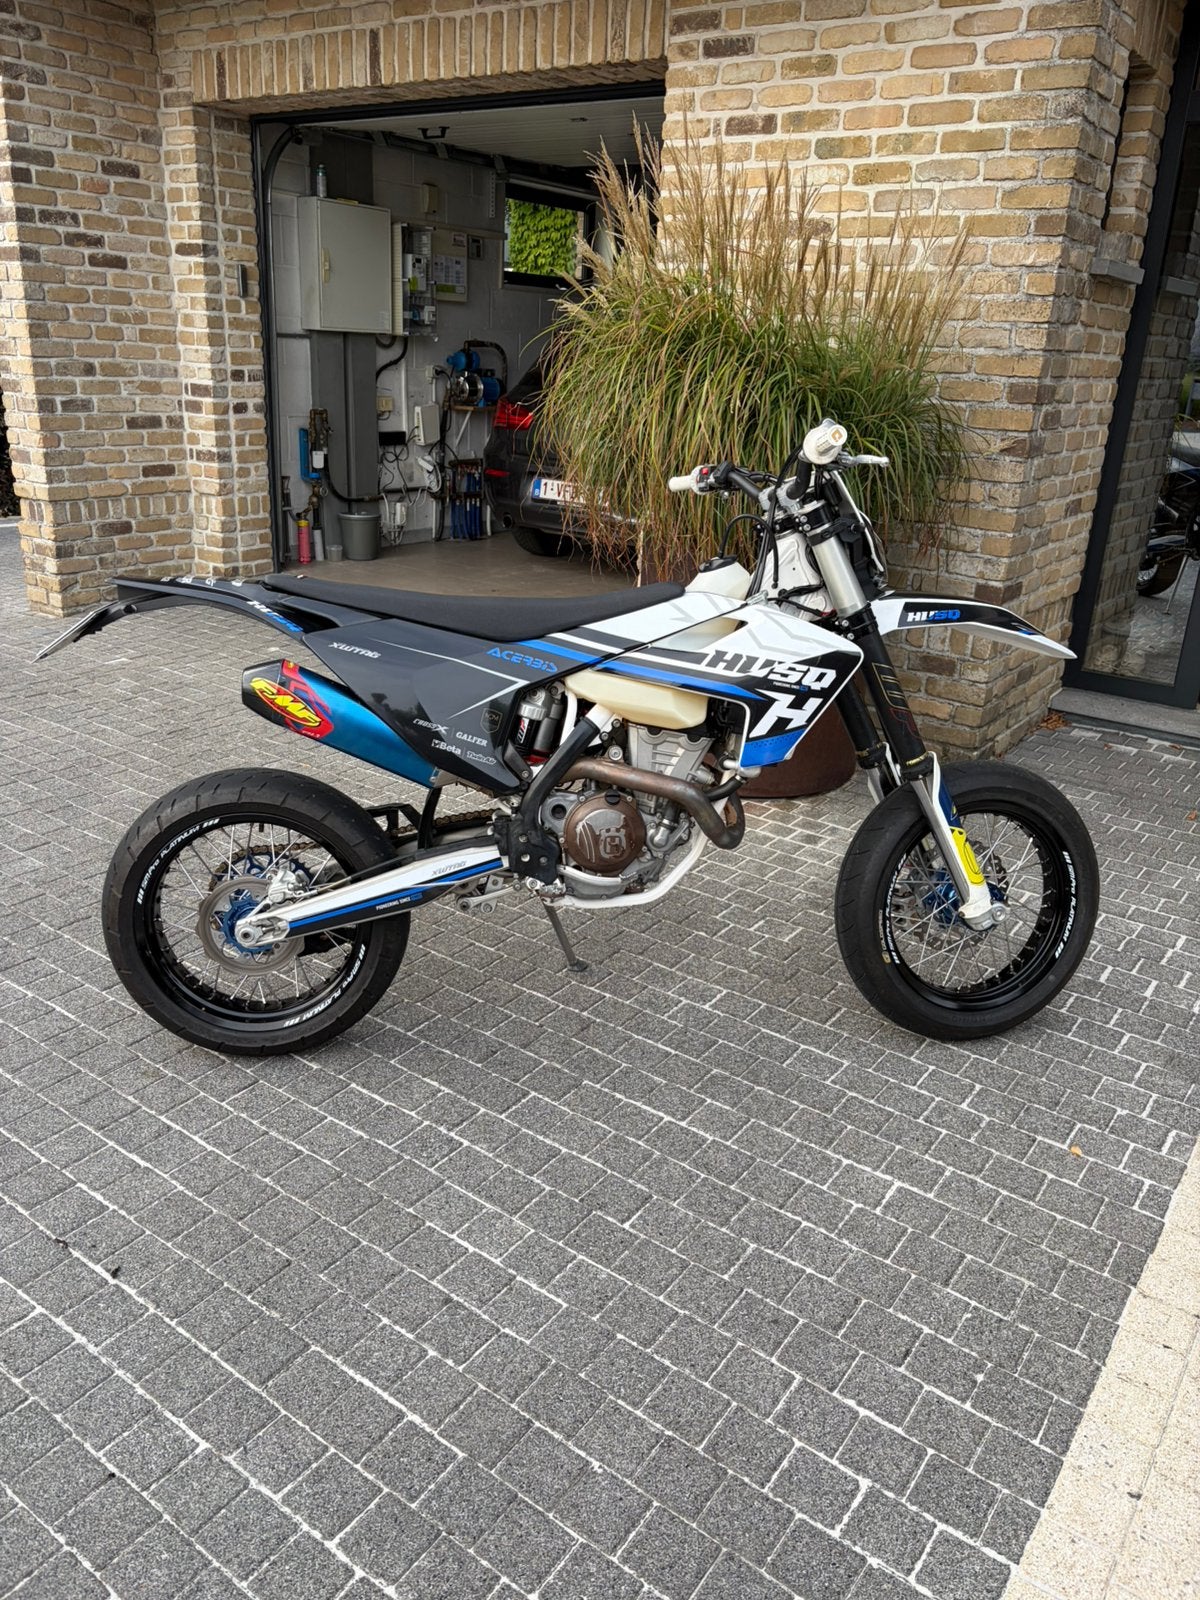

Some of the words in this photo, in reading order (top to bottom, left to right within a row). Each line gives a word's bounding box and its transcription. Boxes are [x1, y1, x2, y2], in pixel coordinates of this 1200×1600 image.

[907, 609, 961, 622] HUSQ
[486, 647, 558, 673] ACERBIS
[704, 649, 837, 691] HUSQ
[249, 677, 322, 727] FMF
[440, 741, 461, 755] Beta
[455, 731, 489, 747] GALFER
